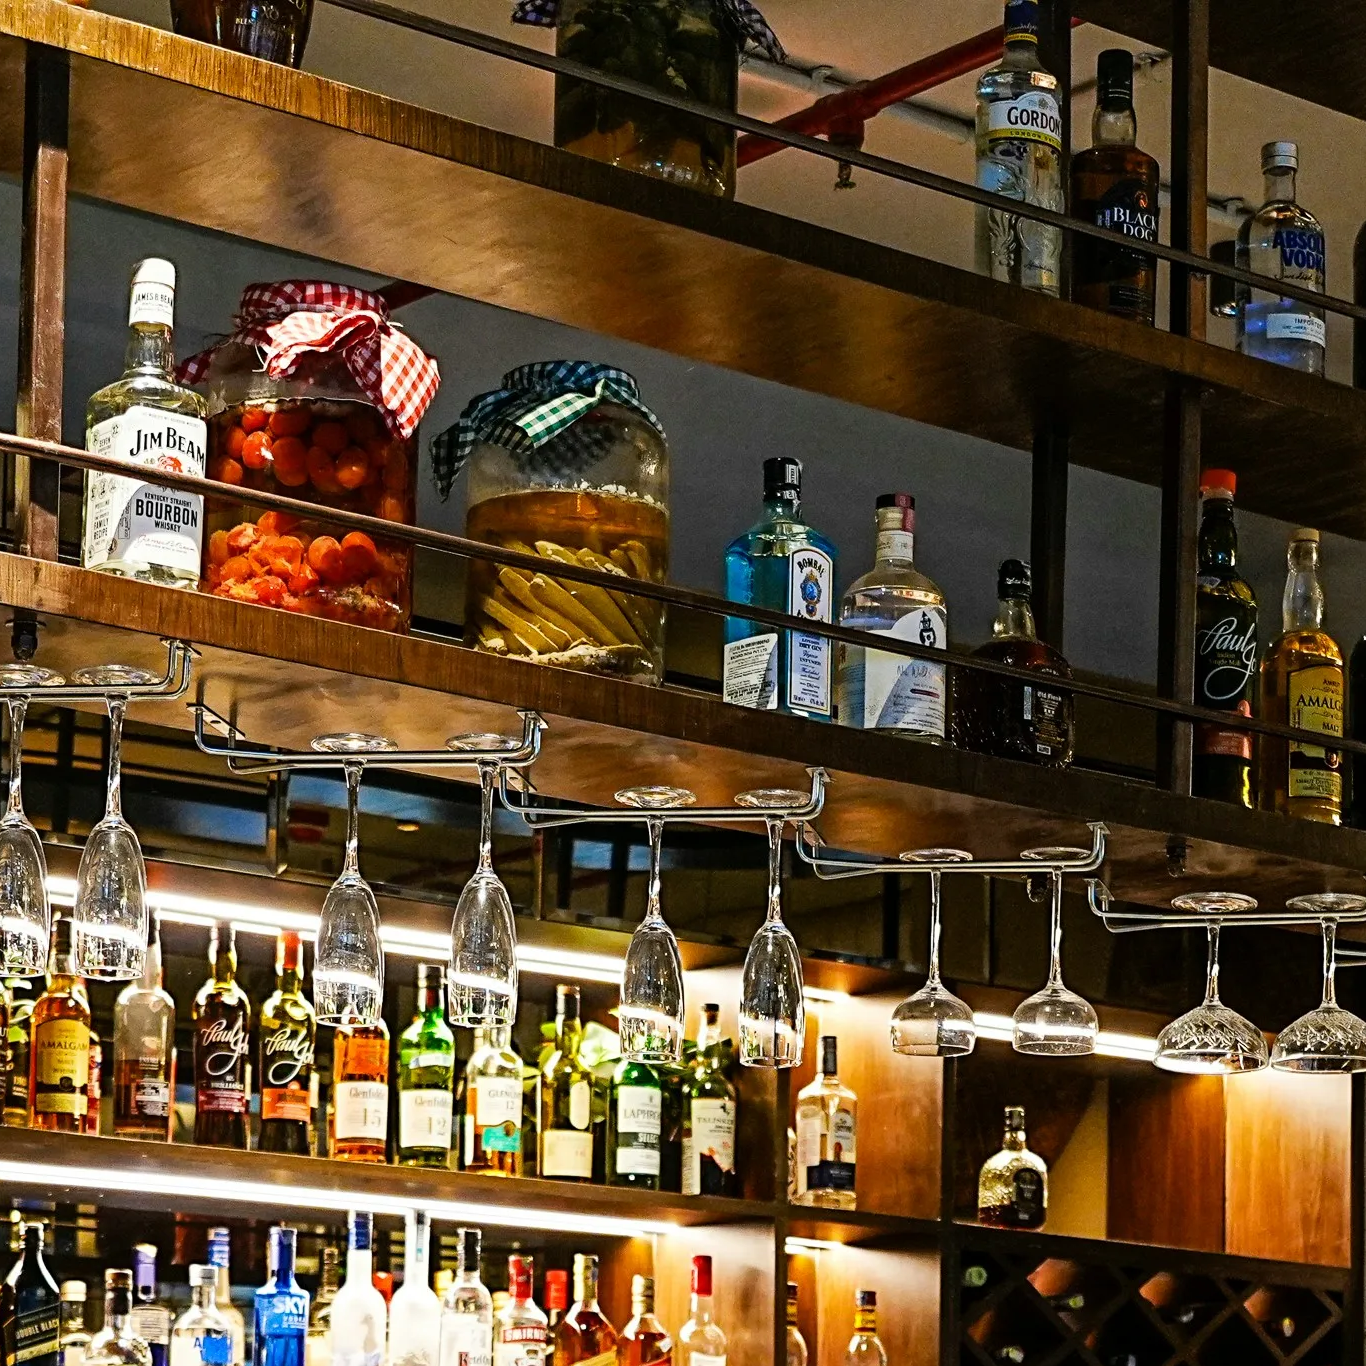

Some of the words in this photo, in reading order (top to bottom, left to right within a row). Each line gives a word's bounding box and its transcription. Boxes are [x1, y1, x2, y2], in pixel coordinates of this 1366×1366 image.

[1123, 223, 1153, 241] DOG
[129, 429, 162, 457] JIM
[166, 427, 205, 472] BEAM
[144, 492, 169, 503] KENTUCKY
[170, 497, 192, 507] STRAIGHT
[135, 499, 198, 528] BOURBON
[154, 519, 181, 533] WHISKEY
